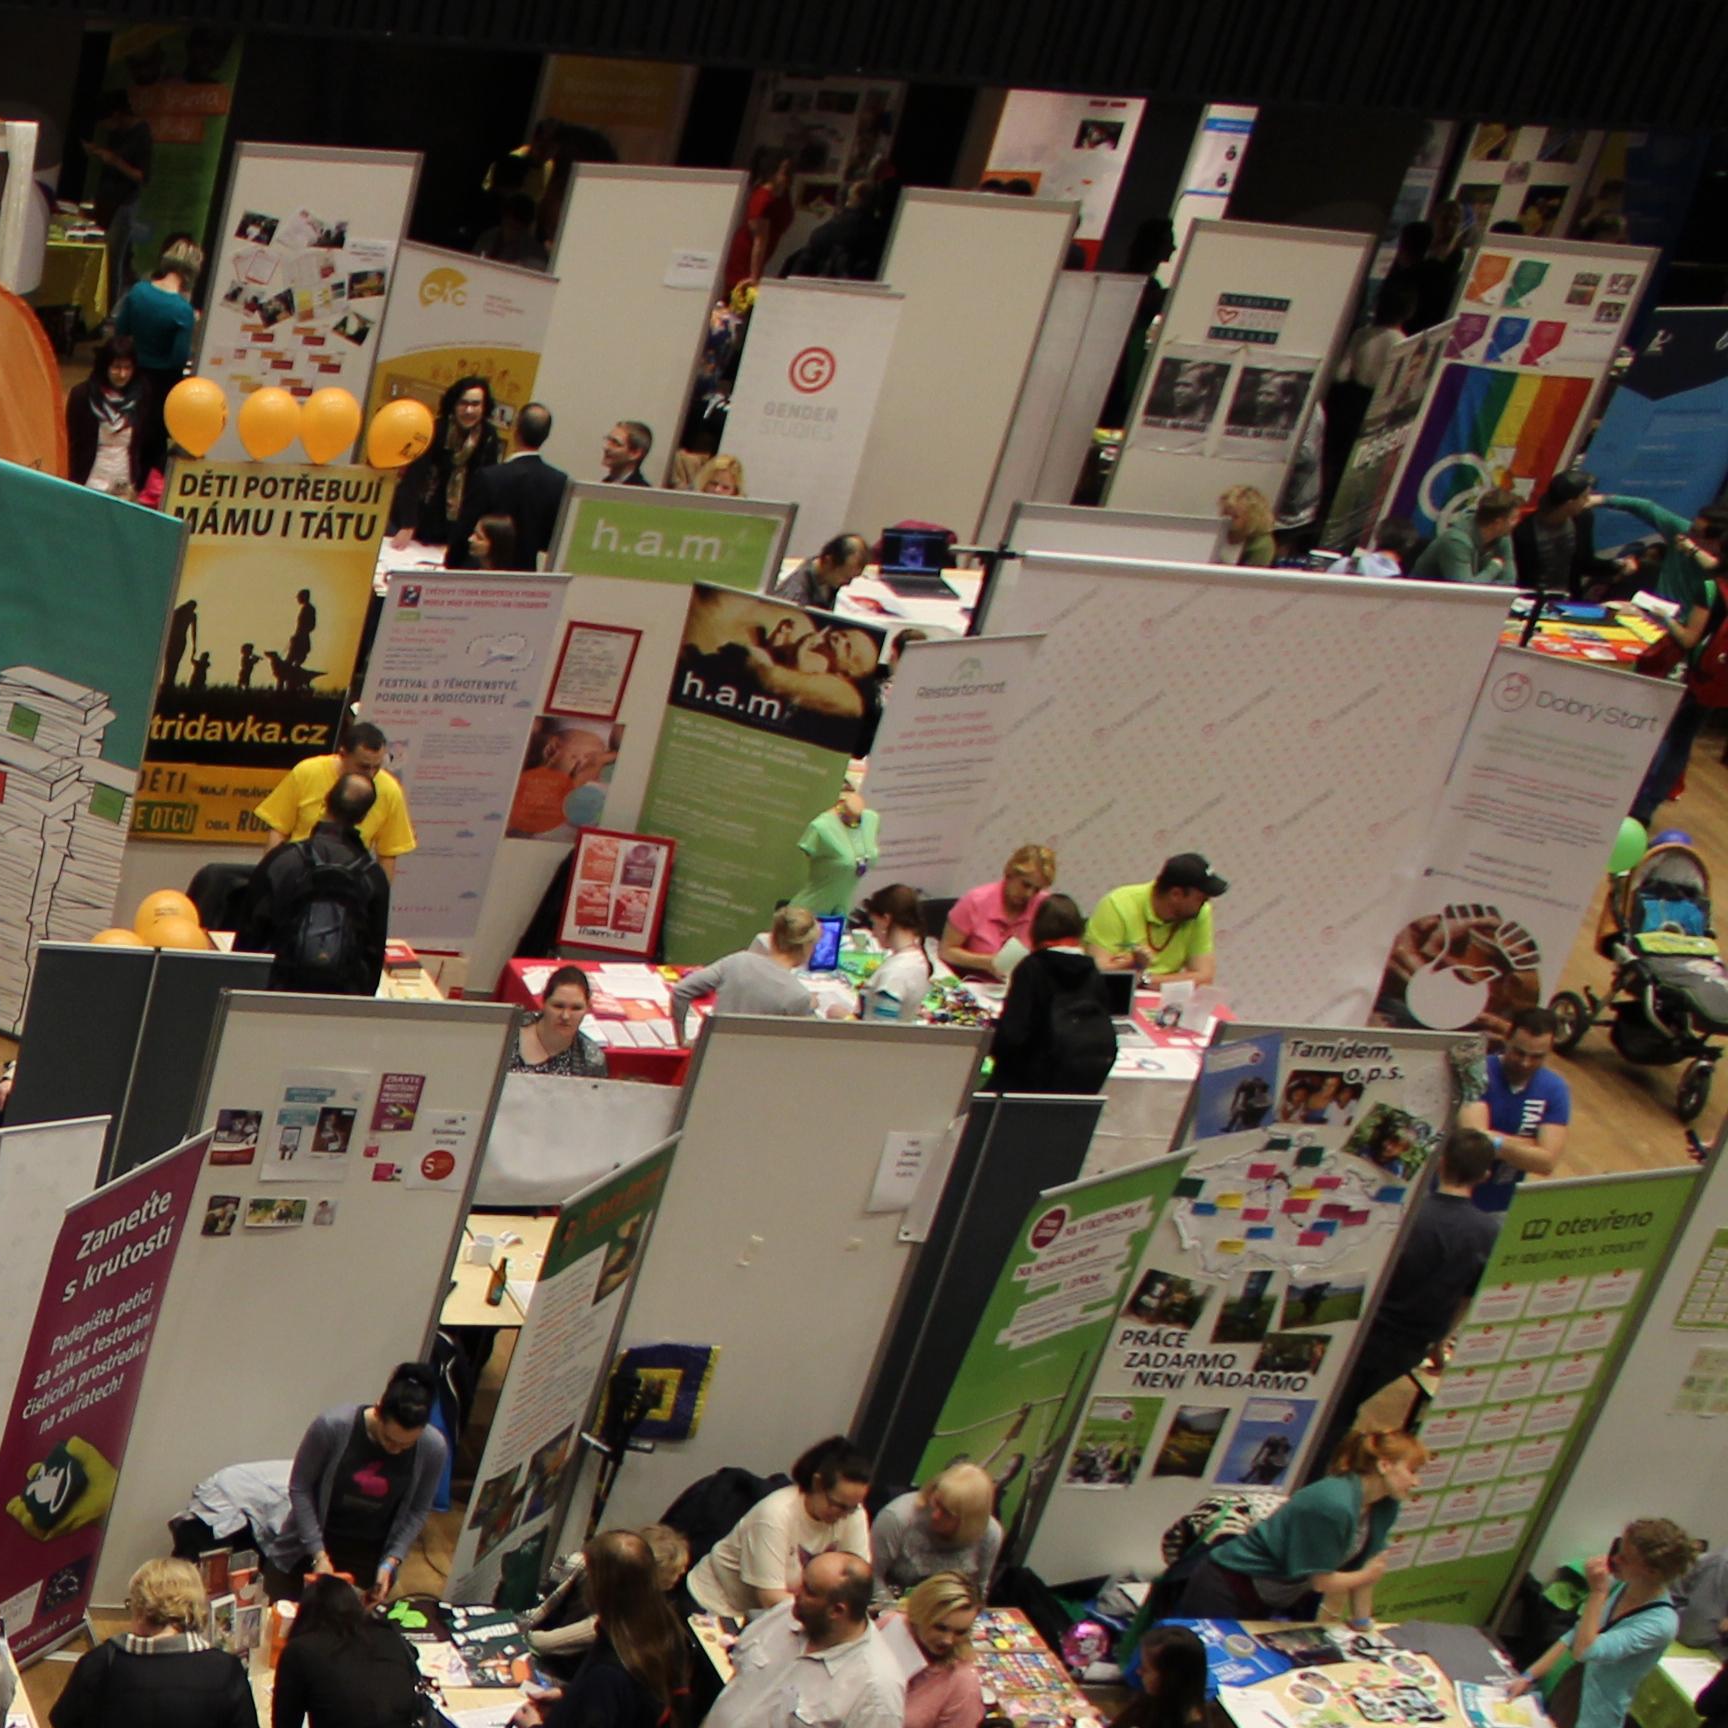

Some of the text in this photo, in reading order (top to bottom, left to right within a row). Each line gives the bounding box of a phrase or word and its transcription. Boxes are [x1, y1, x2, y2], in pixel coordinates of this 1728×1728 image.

[763, 403, 837, 422] GENDER
[180, 469, 382, 505] DĚTI POTŘEBUJÍ
[175, 505, 377, 542] MÁMU I TÁTU
[594, 519, 722, 563] h.a.m
[681, 671, 781, 719] h.a.m
[1536, 691, 1659, 733] Dobrý Start
[1288, 1039, 1393, 1063] Tamjdem,
[1346, 1065, 1405, 1085] o.p.s.
[76, 1189, 171, 1260] Zameťte
[1555, 1210, 1652, 1236] otevřeno
[62, 1217, 174, 1303] s krutostí
[52, 1283, 153, 1355] Podepište petici
[1119, 1329, 1188, 1349] PRÁCE
[1123, 1352, 1236, 1370] ZADARMO
[1133, 1369, 1308, 1392] NENÍ NADARMO
[39, 1372, 124, 1435] na zvířatech!
